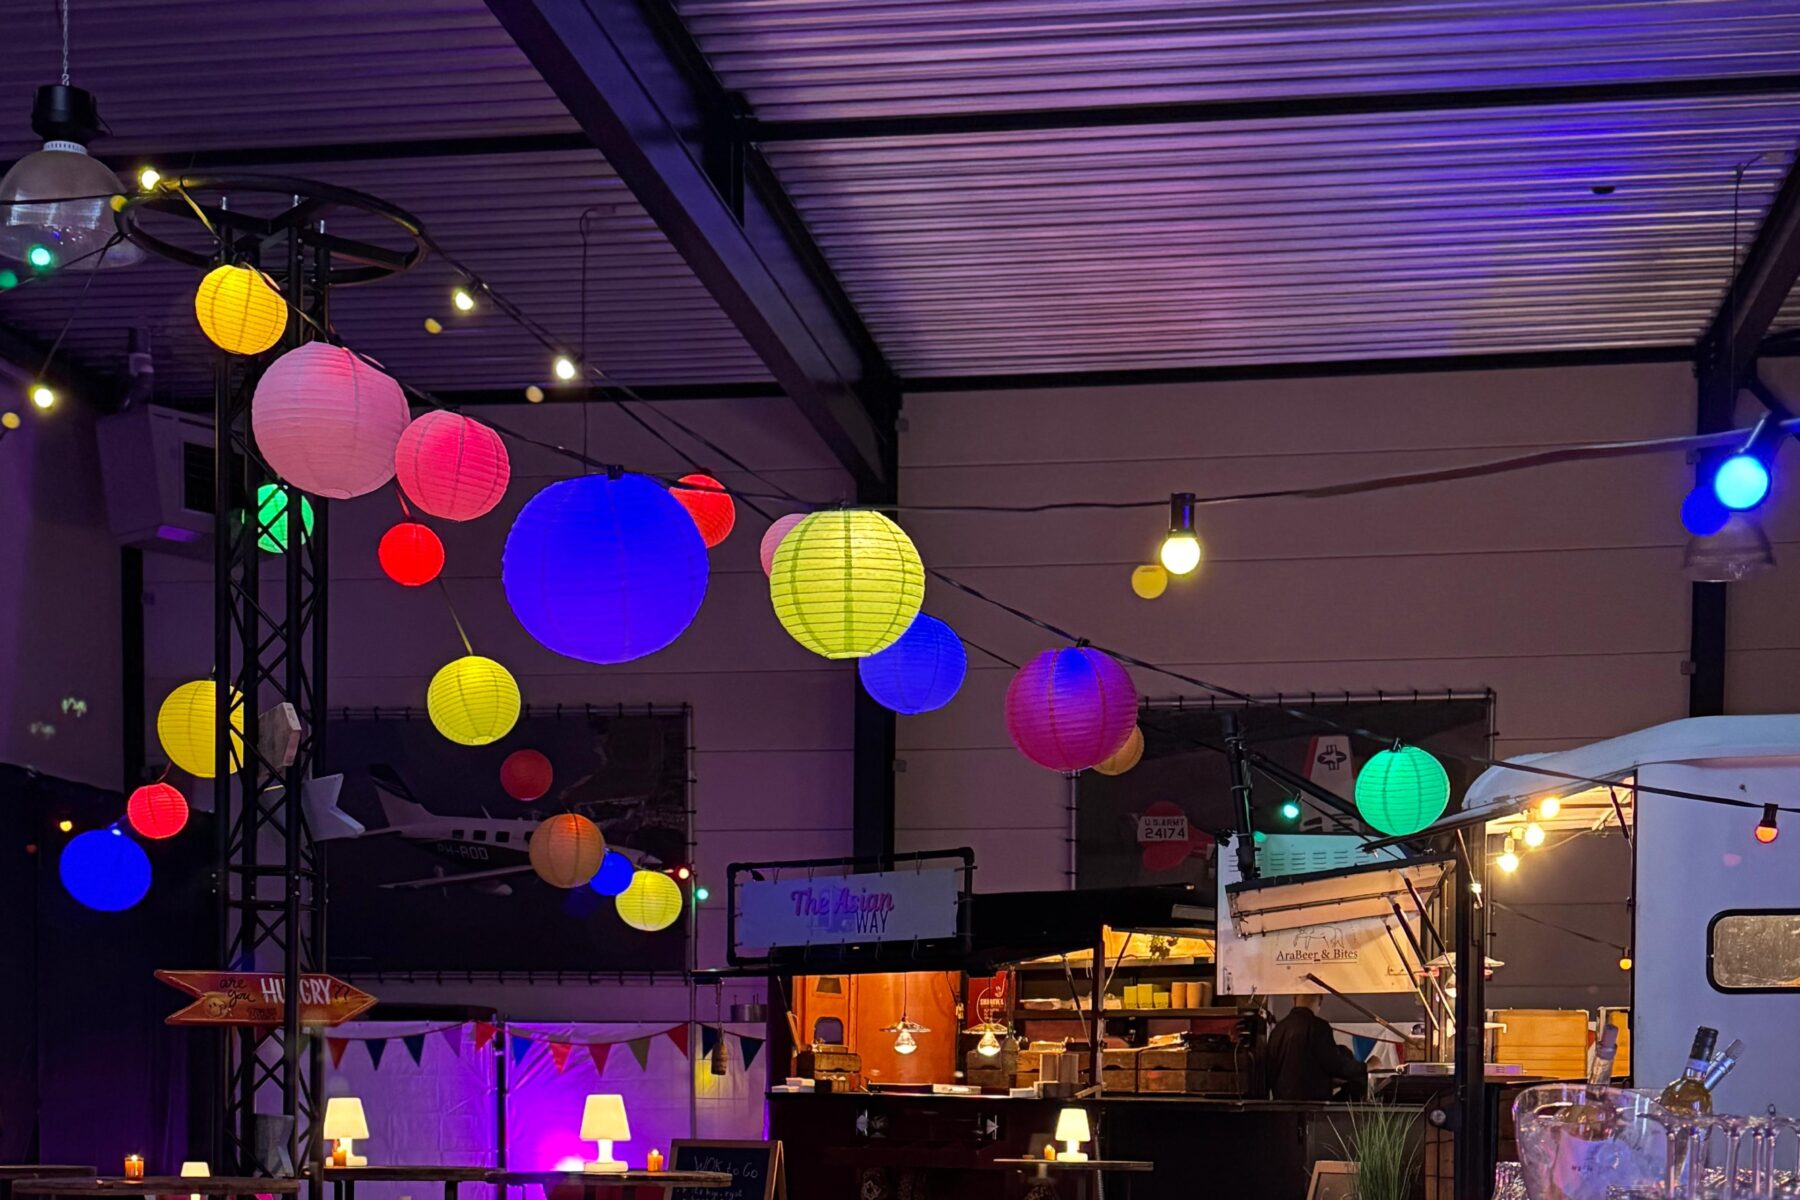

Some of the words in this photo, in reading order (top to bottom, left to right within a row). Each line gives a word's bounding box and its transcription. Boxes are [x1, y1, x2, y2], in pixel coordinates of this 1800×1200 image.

[1144, 827, 1185, 839] 24174
[791, 887, 830, 916] The
[834, 887, 895, 914] Asian
[856, 910, 889, 934] WAY
[1276, 949, 1317, 962] AraBeer
[1320, 949, 1331, 960] &
[1333, 948, 1359, 960] Bites
[219, 977, 248, 989] are
[260, 977, 332, 1006] HUGRY
[227, 989, 256, 1007] you
